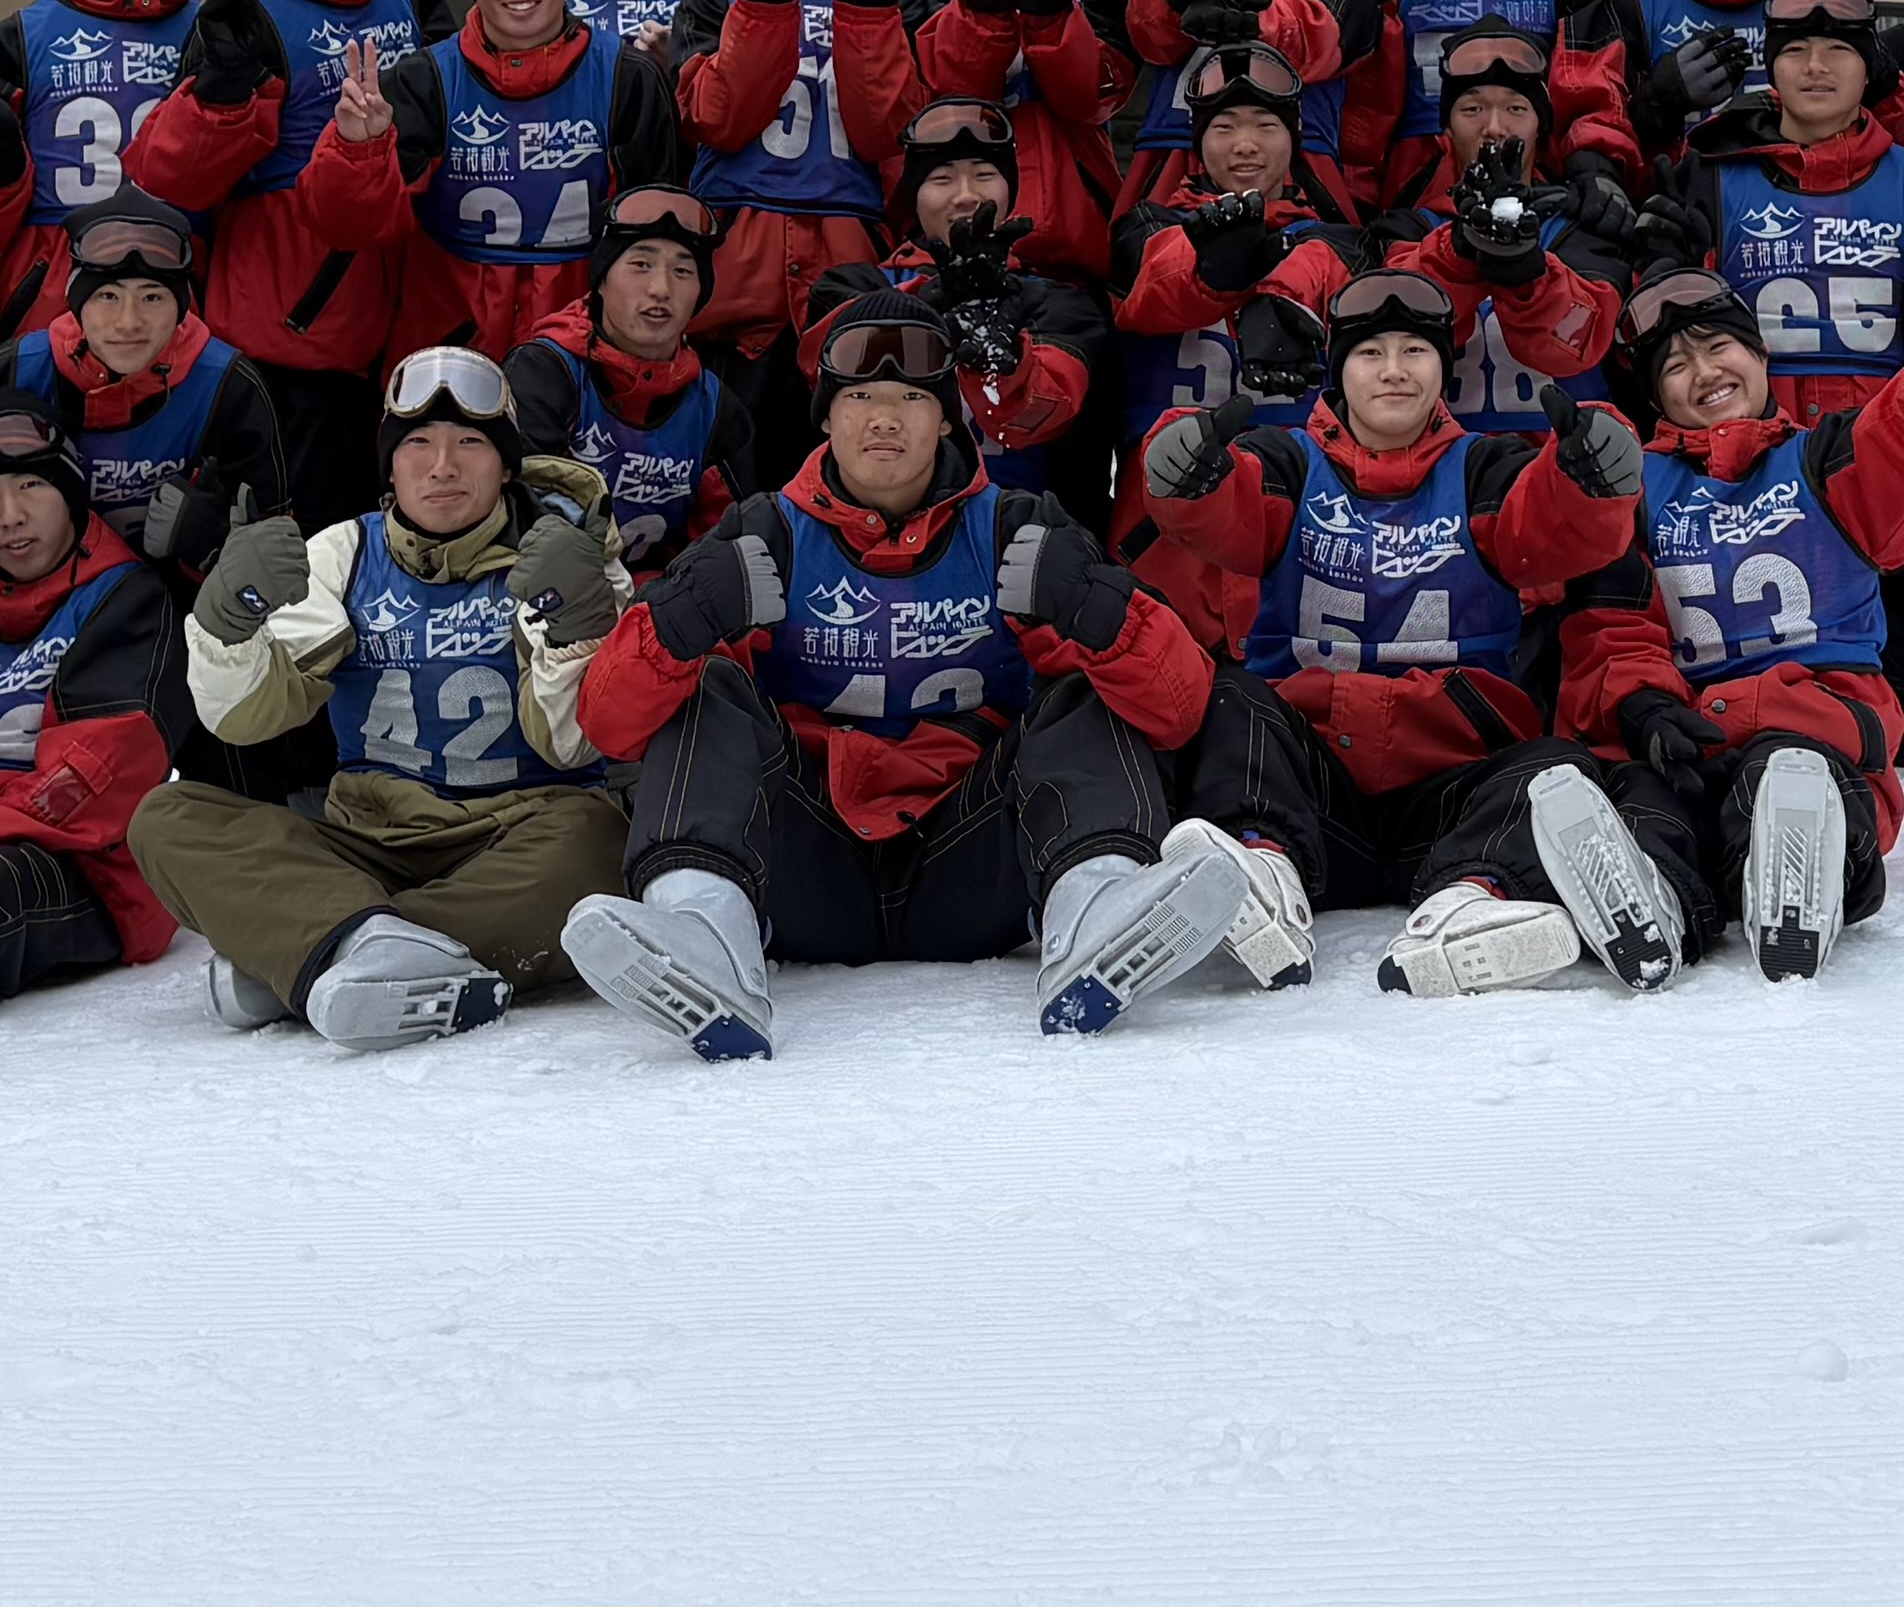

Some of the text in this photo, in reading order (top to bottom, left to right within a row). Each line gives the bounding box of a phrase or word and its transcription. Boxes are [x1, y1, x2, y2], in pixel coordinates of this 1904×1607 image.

[55, 96, 161, 206] 3
[1172, 317, 1297, 408] 5
[1292, 574, 1458, 673] 54
[1655, 553, 1818, 667] 53
[360, 665, 518, 786] 42
